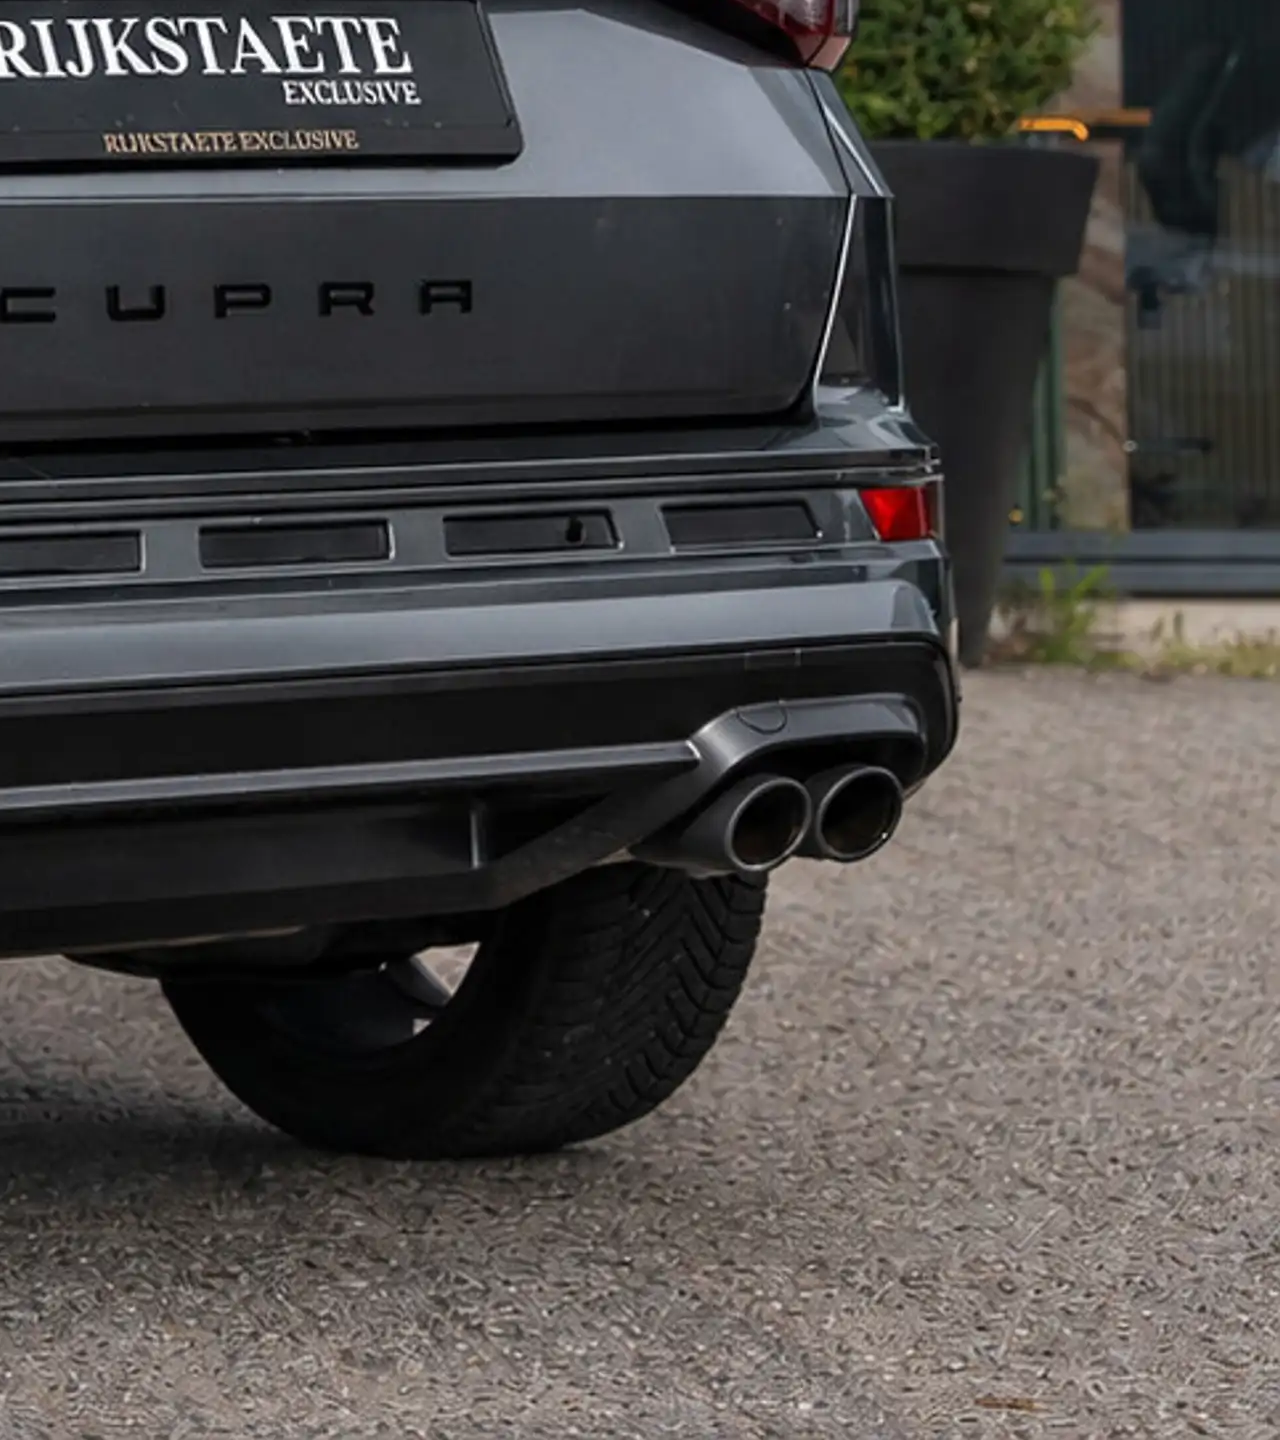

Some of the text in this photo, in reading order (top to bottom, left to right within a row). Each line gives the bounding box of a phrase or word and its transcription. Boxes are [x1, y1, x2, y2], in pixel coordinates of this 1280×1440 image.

[282, 79, 421, 106] EXCLUSIVE
[103, 129, 360, 153] RIJKSTAETE EXCLUSIVE
